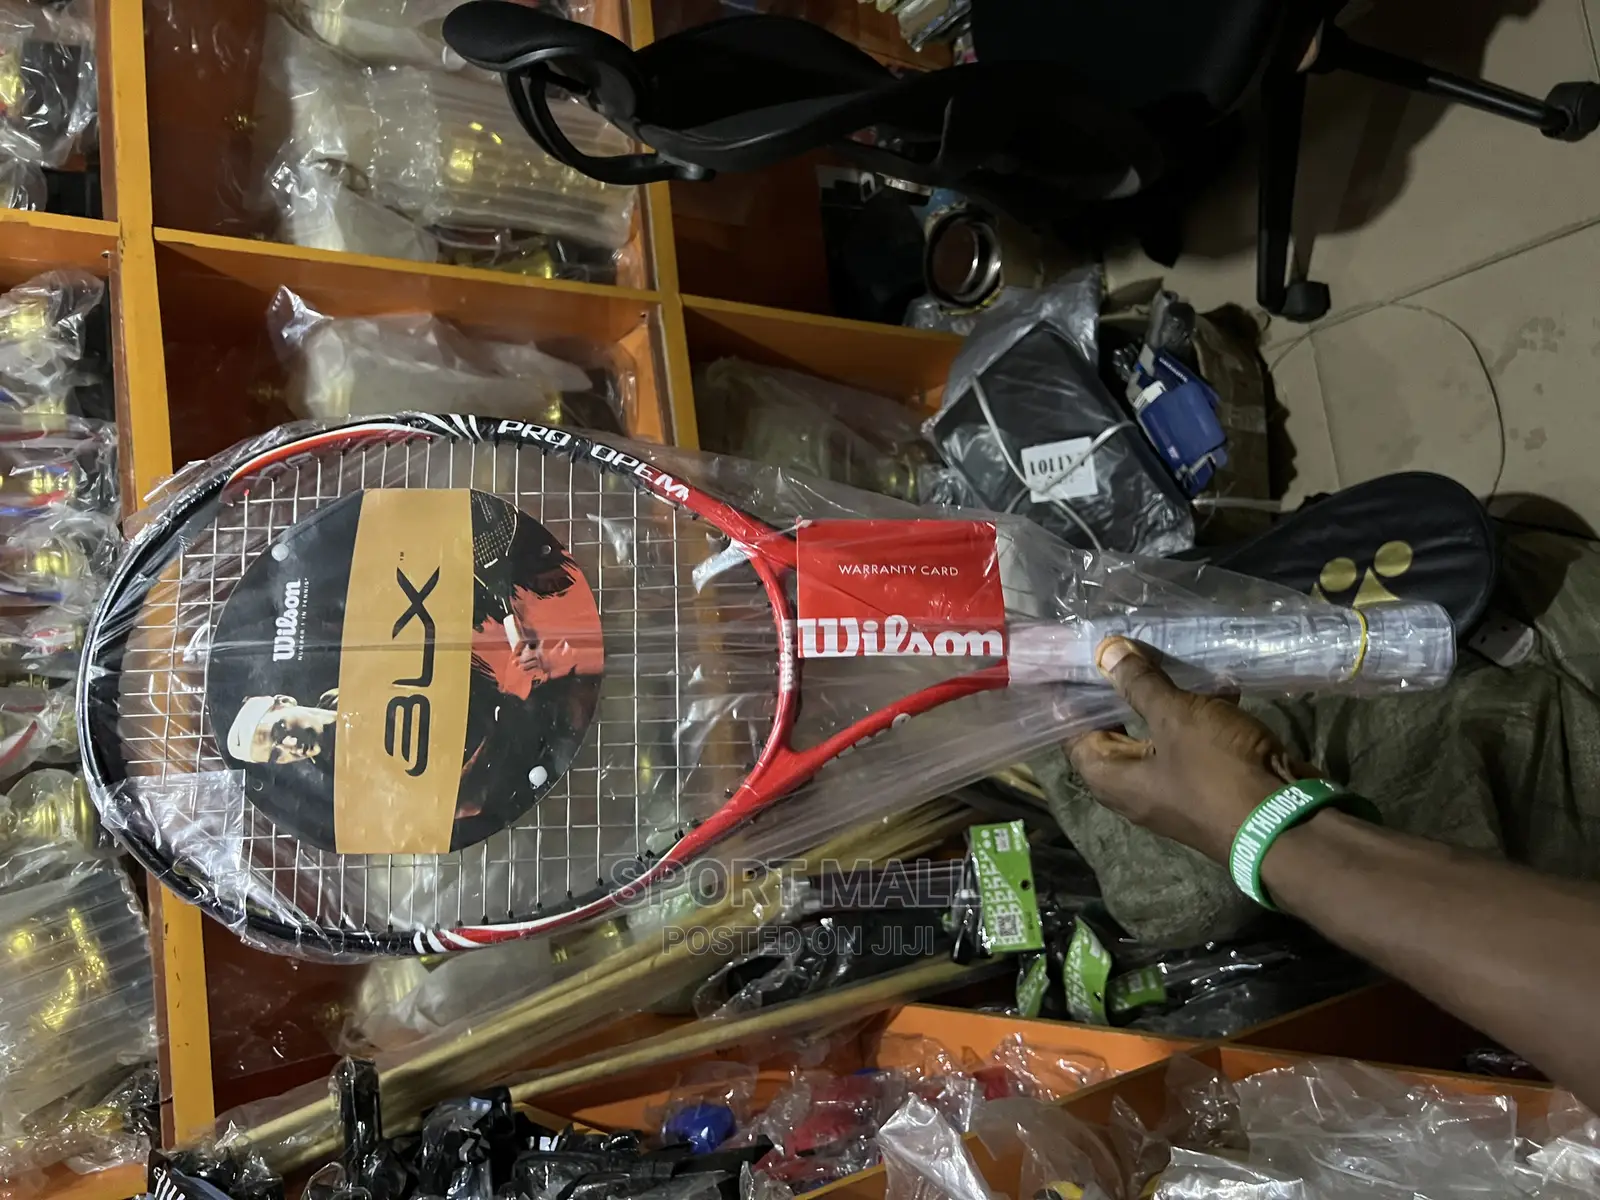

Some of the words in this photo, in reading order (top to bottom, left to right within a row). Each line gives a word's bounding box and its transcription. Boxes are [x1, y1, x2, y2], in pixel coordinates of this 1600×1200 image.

[497, 419, 572, 447] PRO
[838, 564, 917, 576] WARRANTY
[920, 565, 959, 577] CARD
[272, 579, 301, 662] Wilson
[797, 614, 1004, 658] Wilson
[384, 565, 441, 777] BLX
[1245, 785, 1314, 840] THUNDER
